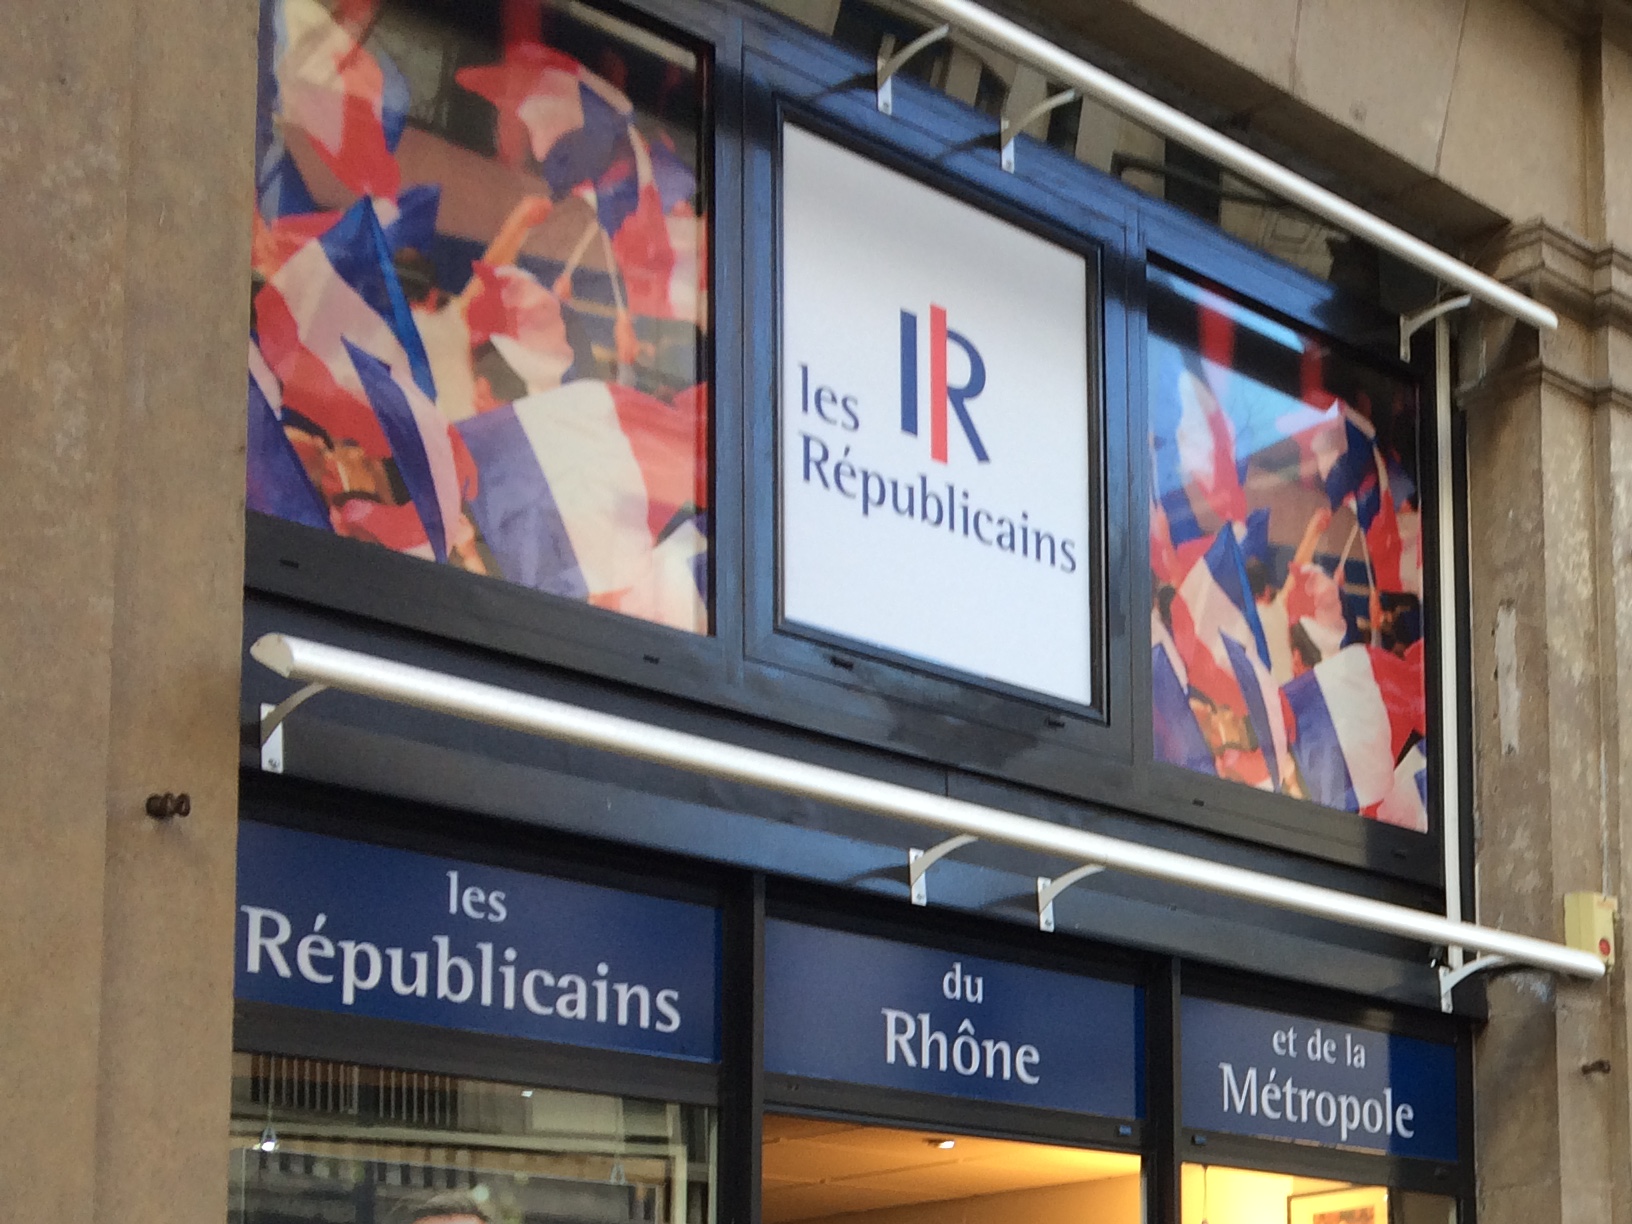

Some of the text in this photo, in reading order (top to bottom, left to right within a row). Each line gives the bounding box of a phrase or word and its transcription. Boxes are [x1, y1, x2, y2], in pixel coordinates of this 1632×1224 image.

[799, 361, 860, 433] les
[799, 430, 1077, 574] Républicains
[446, 870, 508, 922] les
[239, 904, 682, 1034] Républicains
[942, 961, 984, 1004] du
[880, 1007, 1041, 1085] Rhône
[1272, 1026, 1366, 1069] et de la
[1218, 1061, 1415, 1142] Métropole
